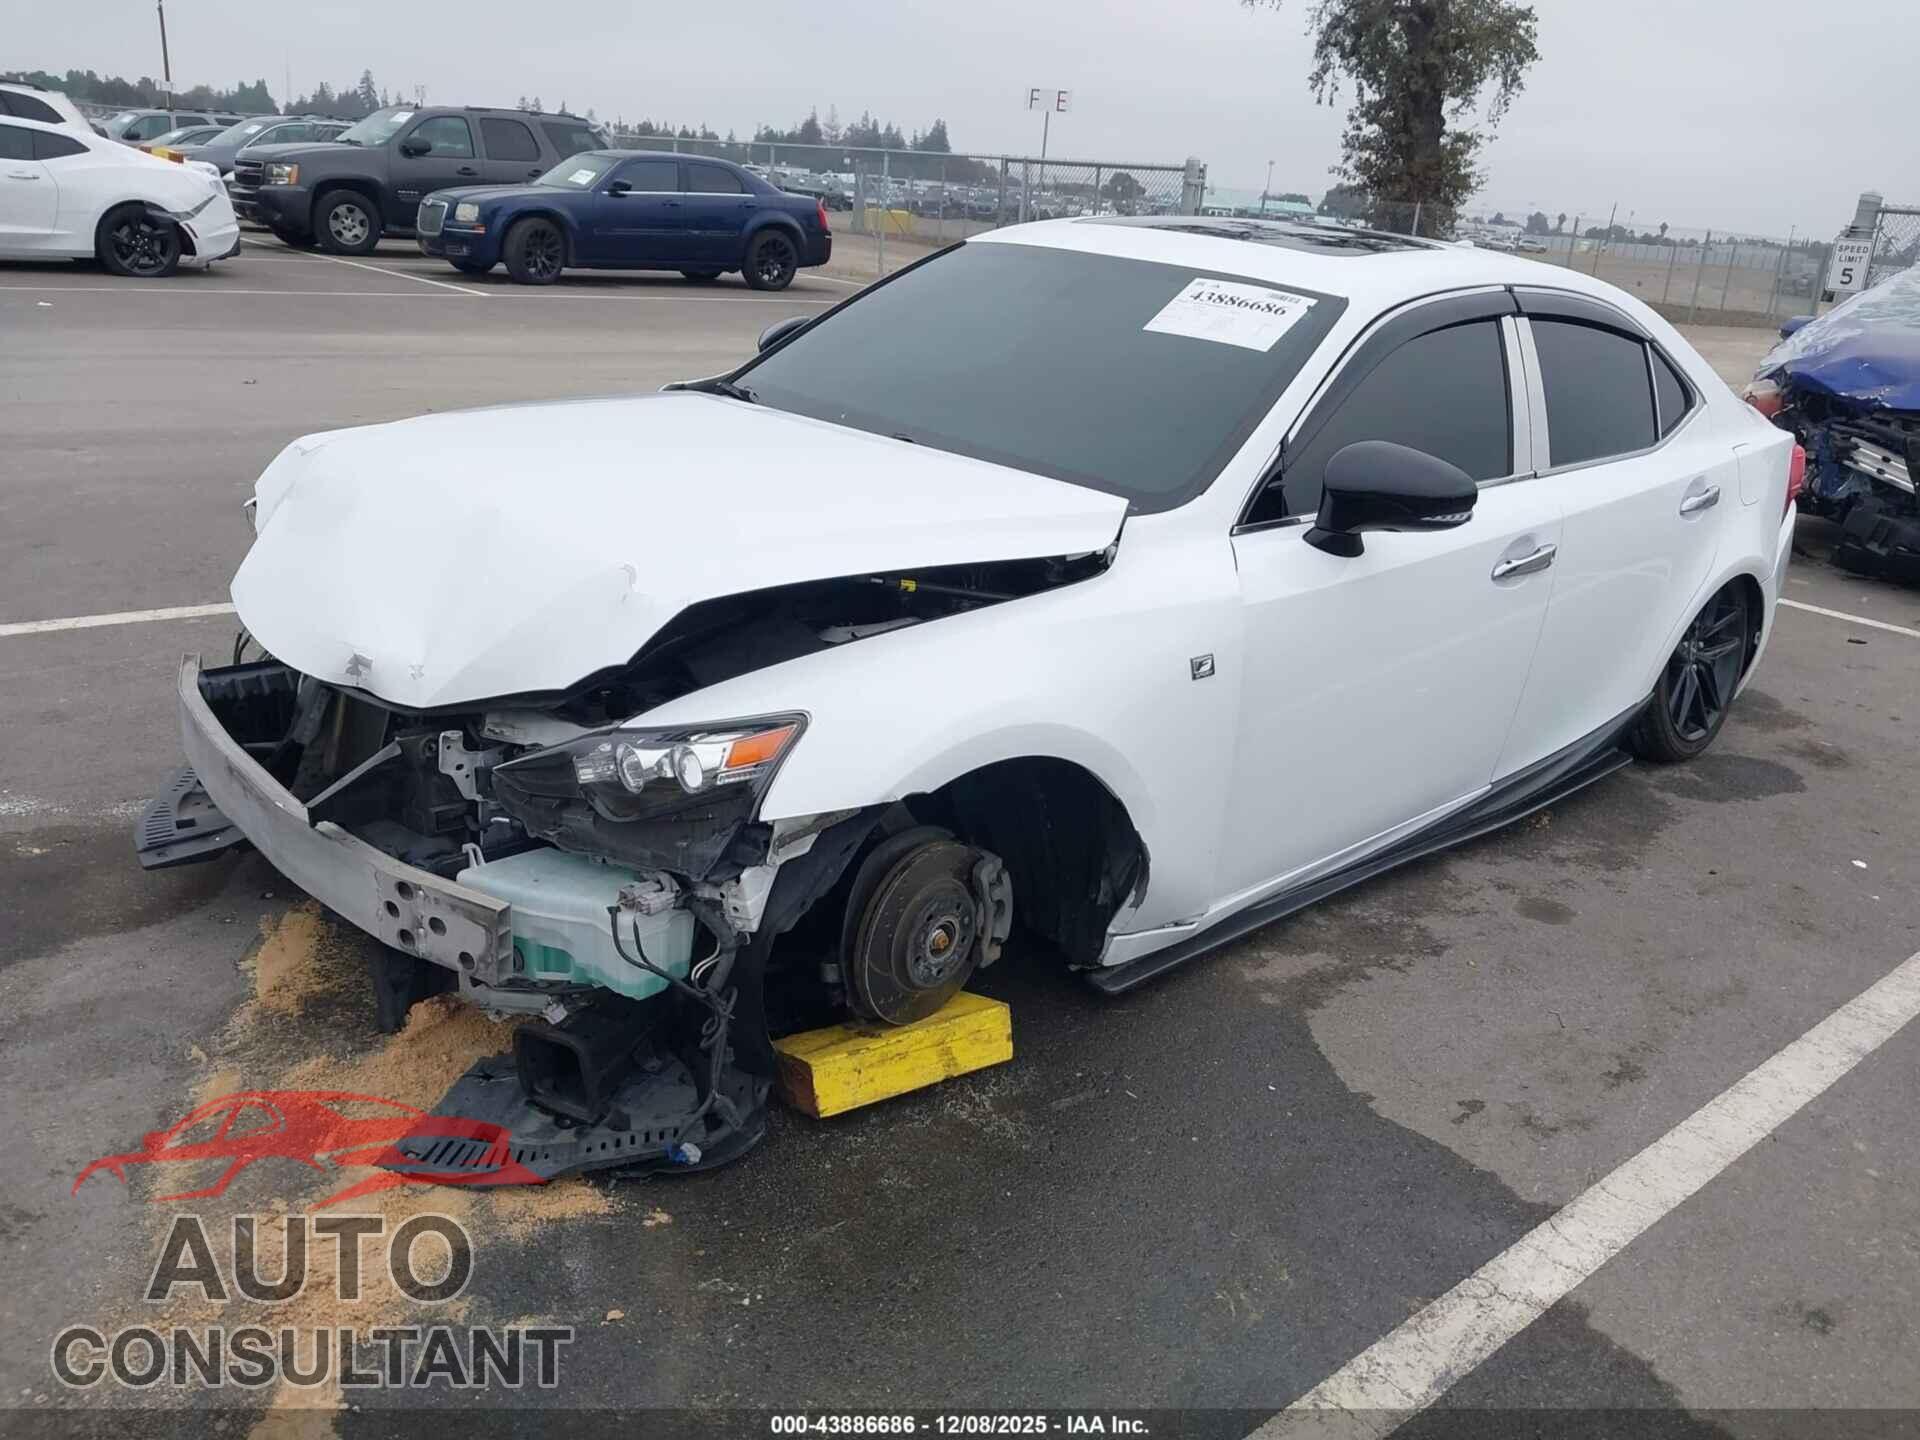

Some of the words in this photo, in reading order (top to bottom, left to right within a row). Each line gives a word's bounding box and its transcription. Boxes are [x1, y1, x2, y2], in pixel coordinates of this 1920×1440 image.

[1056, 90, 1068, 112] E
[1838, 245, 1869, 254] SPEED
[1839, 255, 1863, 263] LIMIT
[1839, 267, 1854, 285] 5
[1190, 290, 1287, 316] 43886686
